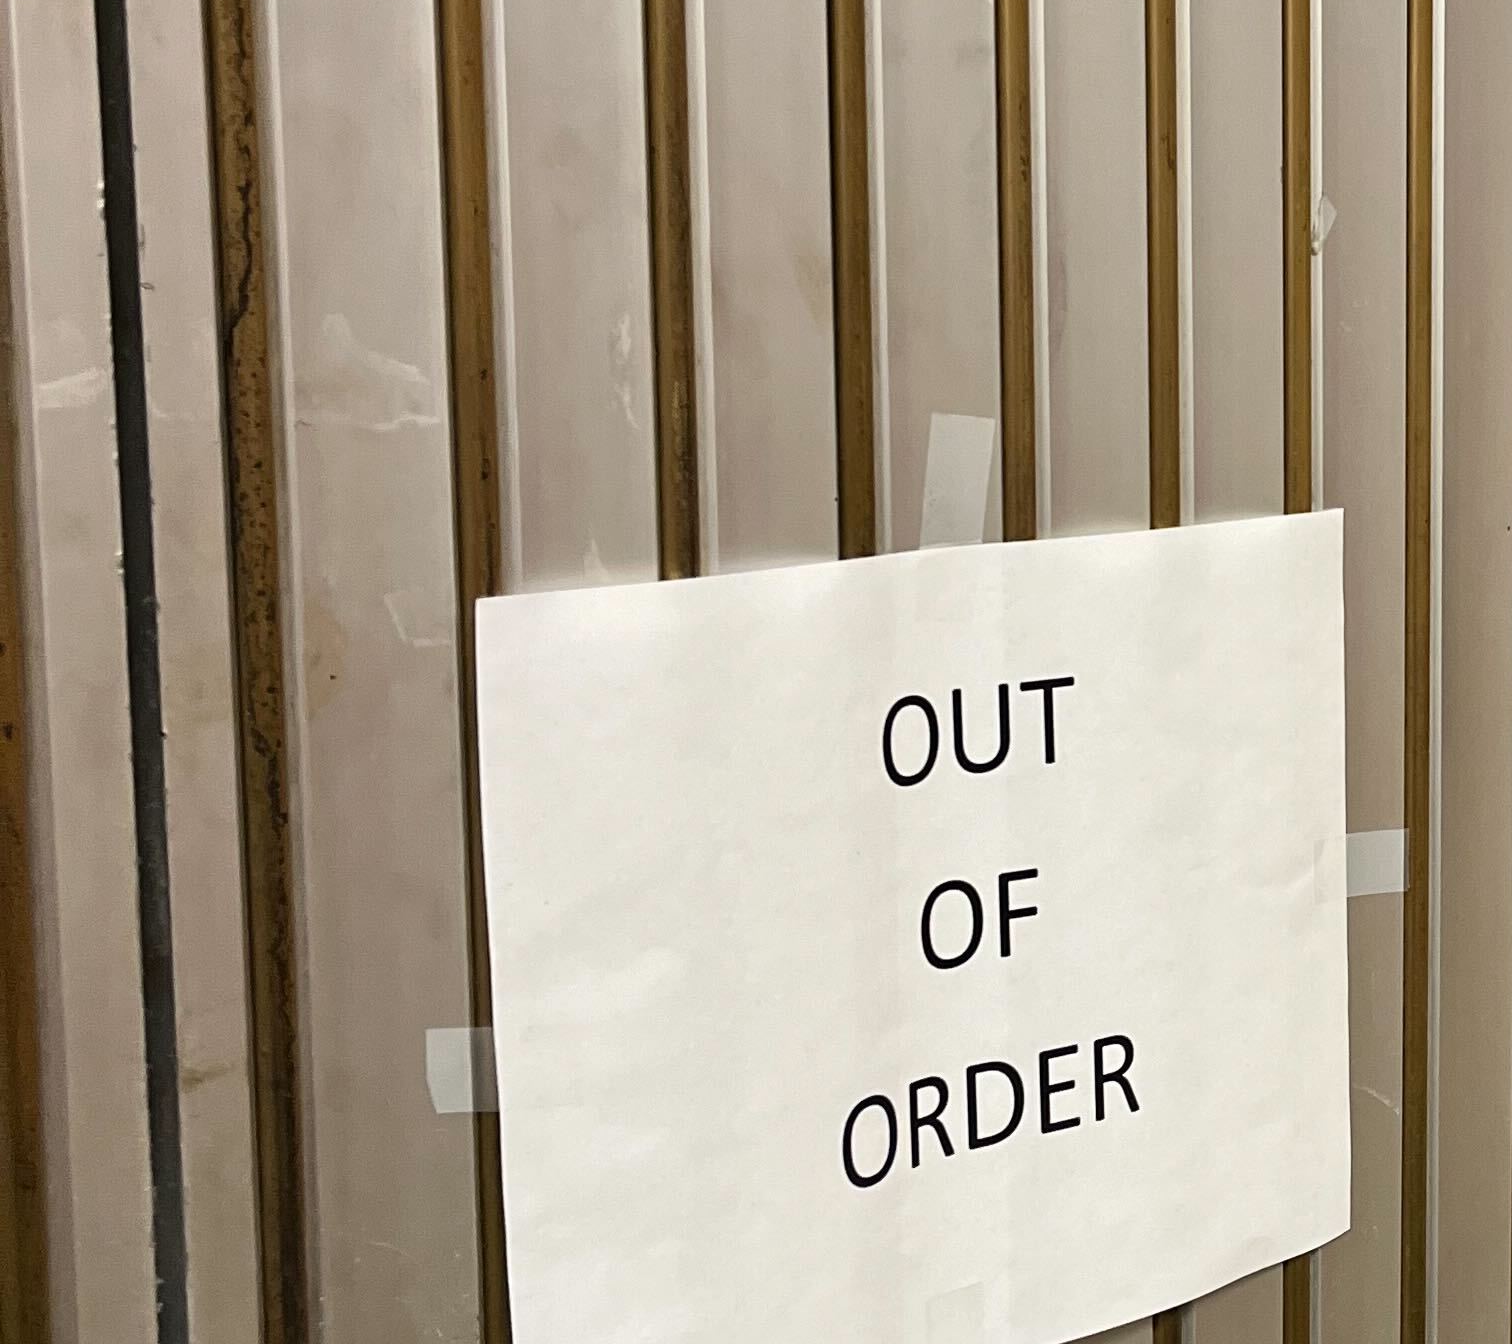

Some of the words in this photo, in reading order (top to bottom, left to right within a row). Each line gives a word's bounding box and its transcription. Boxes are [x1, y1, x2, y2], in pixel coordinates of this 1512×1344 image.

[882, 676, 1075, 787] OUT
[920, 868, 1039, 970] OF
[842, 1034, 1140, 1188] ORDER
